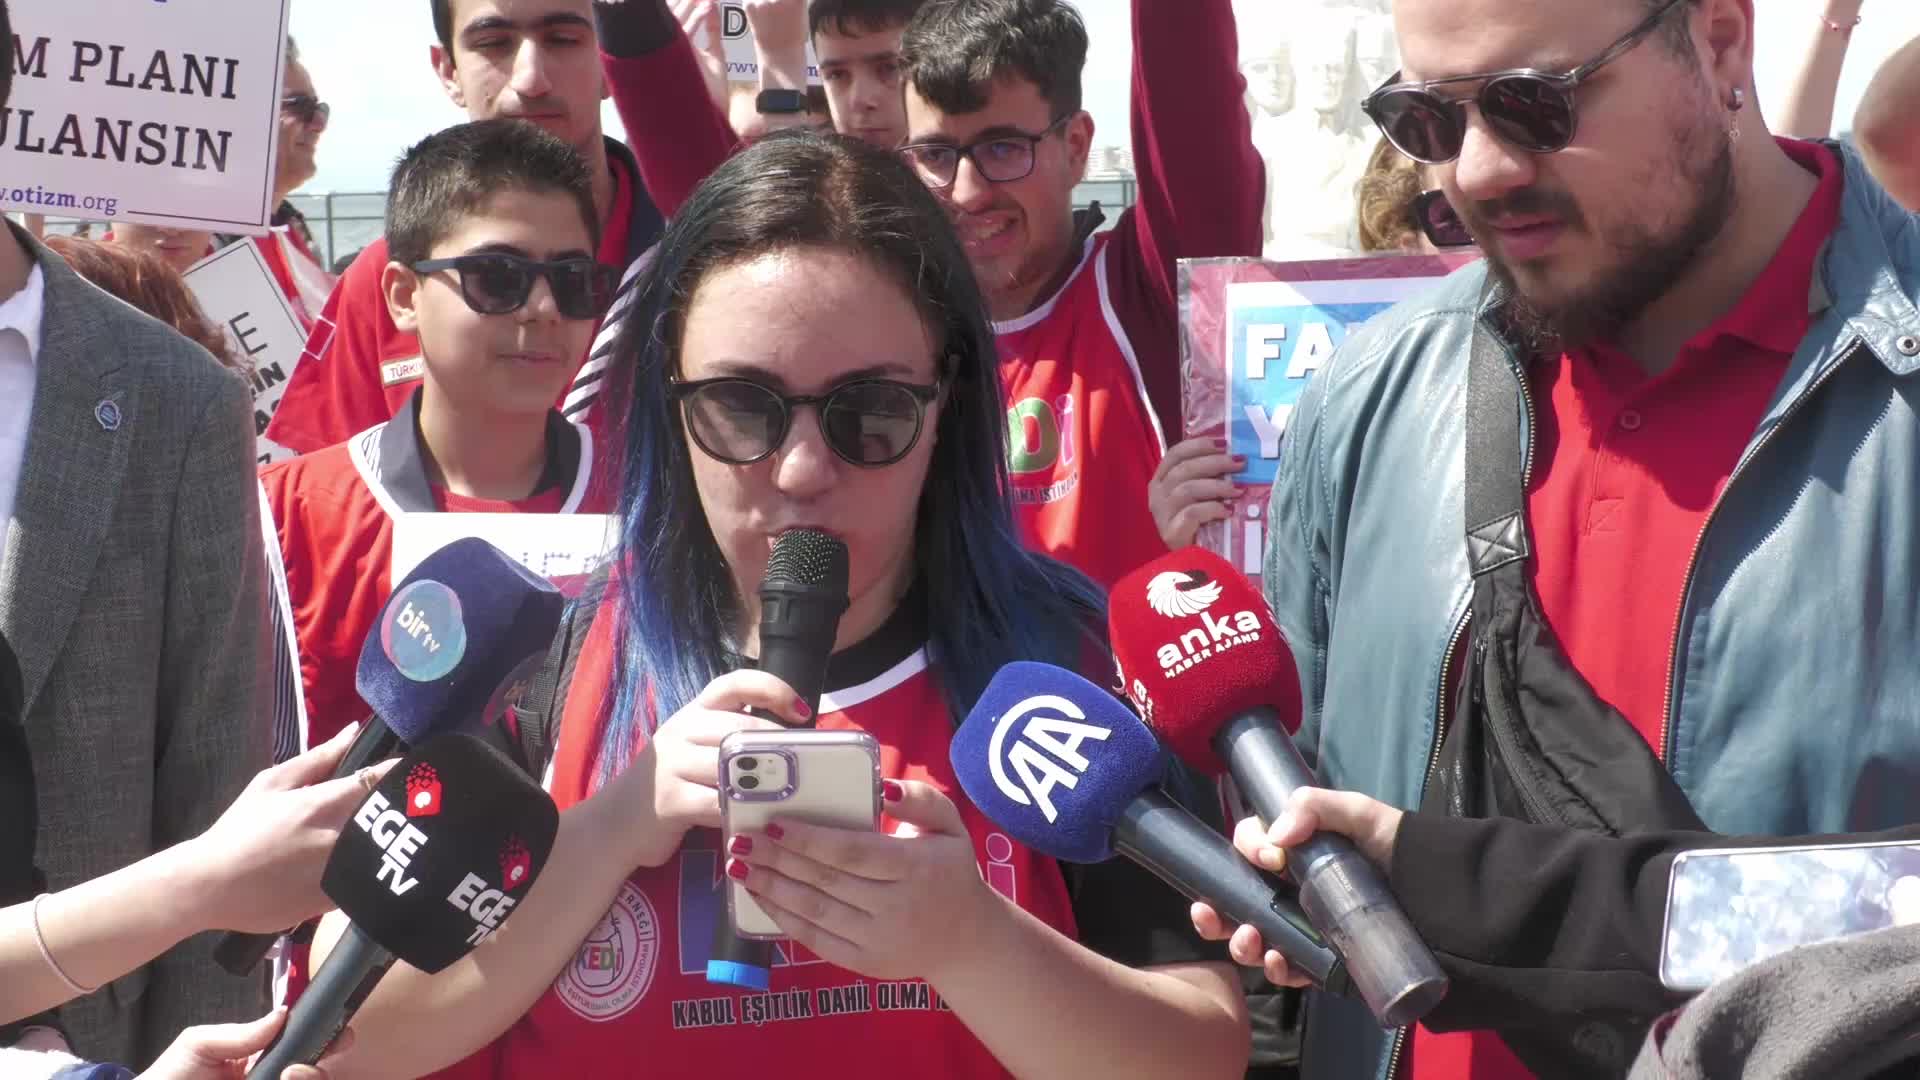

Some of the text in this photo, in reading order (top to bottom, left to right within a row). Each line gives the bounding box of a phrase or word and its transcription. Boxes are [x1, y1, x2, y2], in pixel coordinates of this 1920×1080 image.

[69, 41, 239, 99] PLANI
[397, 601, 430, 638] bir
[1157, 610, 1261, 669] anka
[1165, 648, 1212, 679] HABER
[354, 790, 429, 869] EGE
[376, 853, 419, 896] TV
[447, 872, 516, 928] EGE
[672, 999, 737, 1029] KABUL
[740, 988, 812, 1026] EŞİTLİK
[816, 980, 872, 1016] DAHİL
[877, 982, 931, 1010] OLMA
